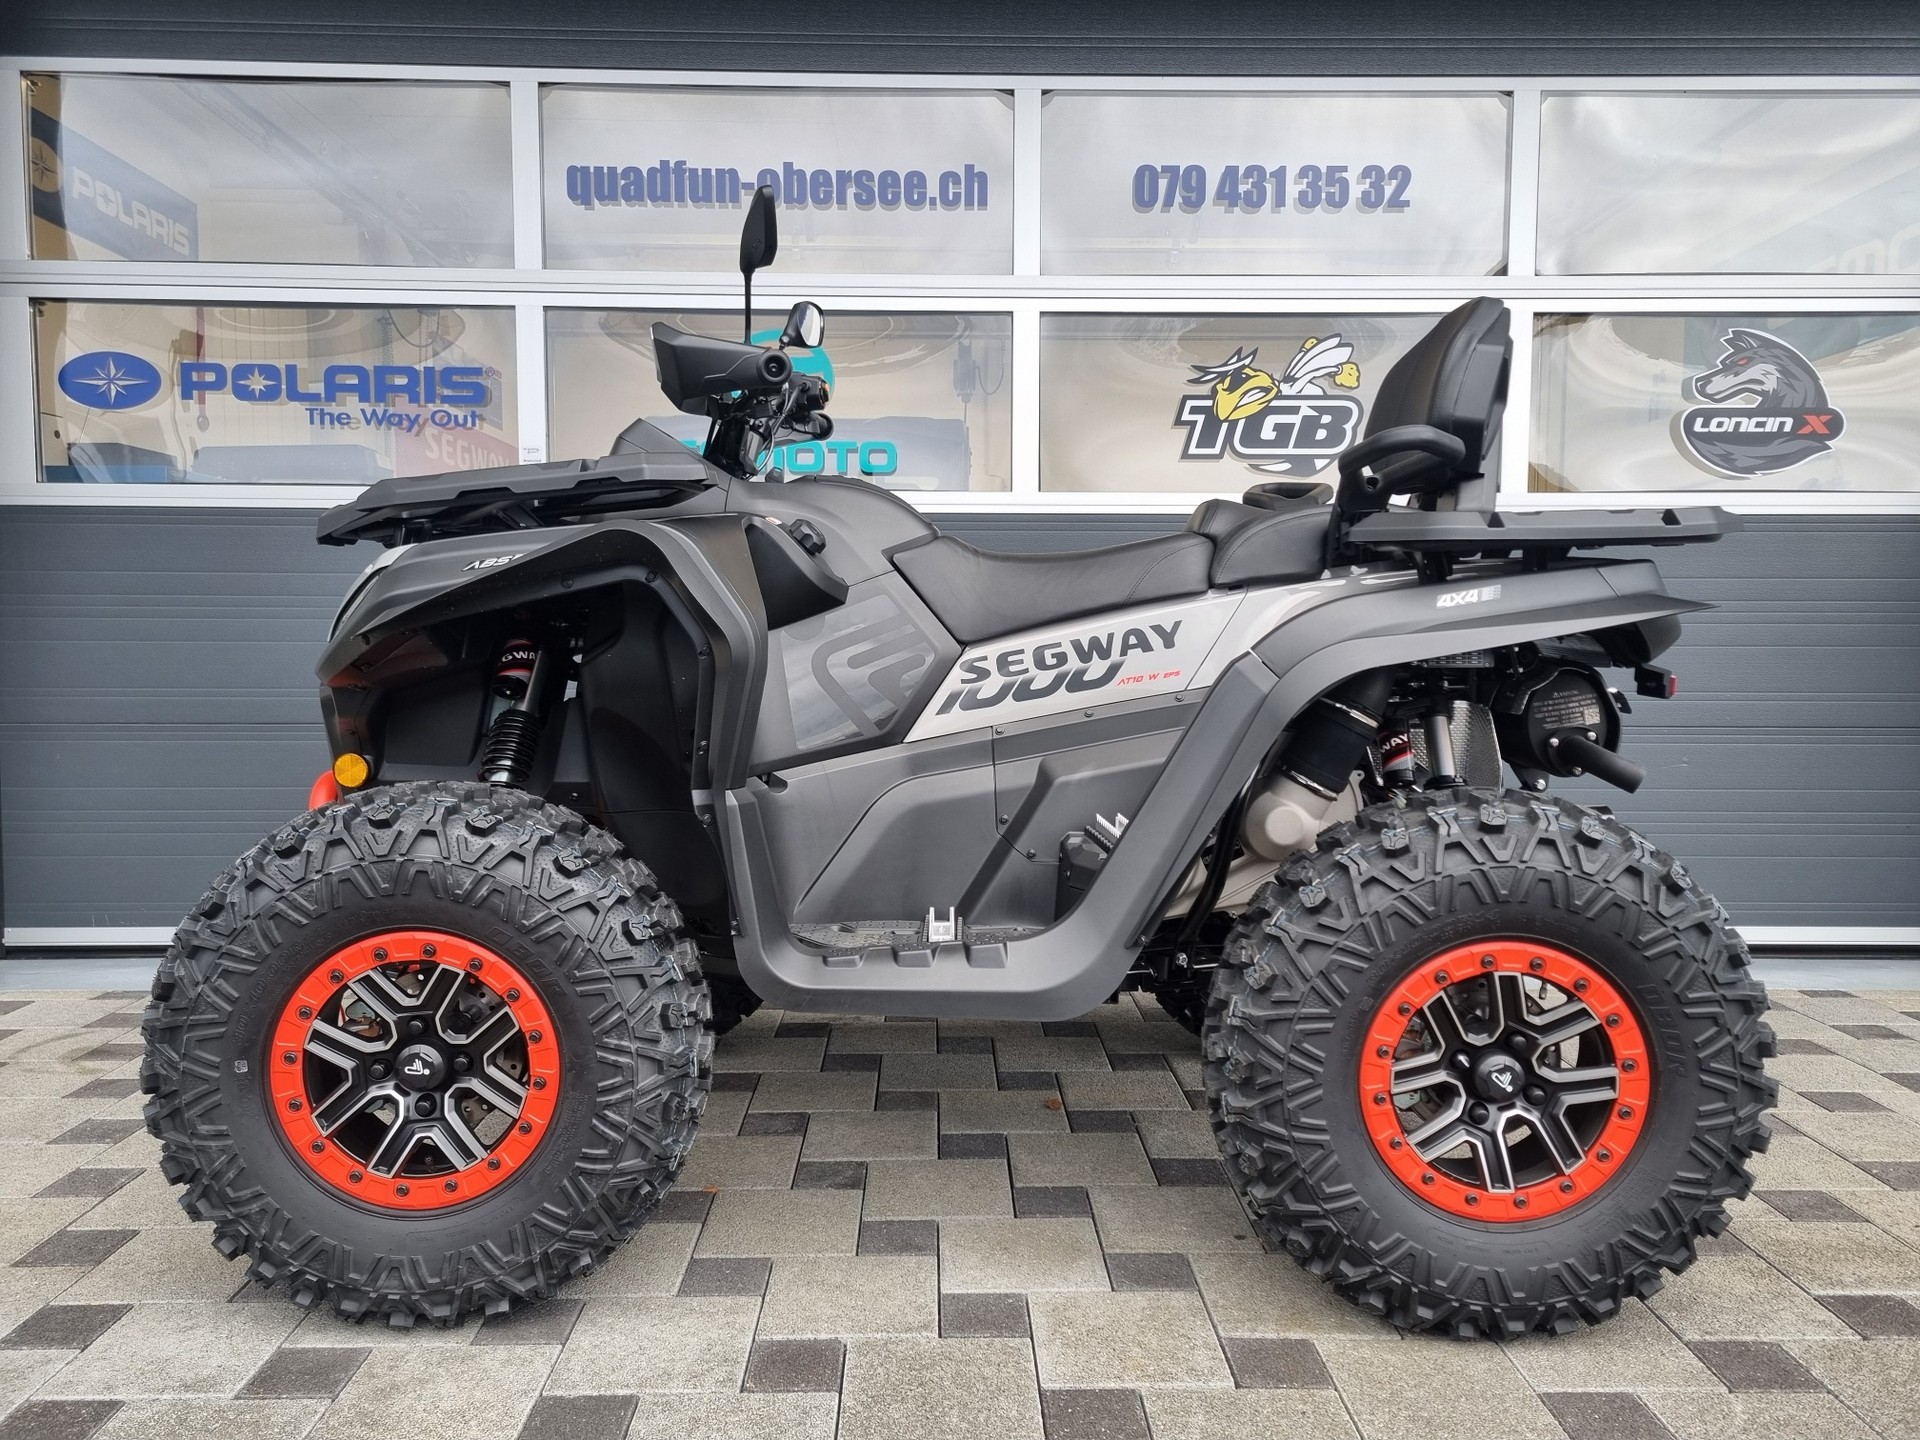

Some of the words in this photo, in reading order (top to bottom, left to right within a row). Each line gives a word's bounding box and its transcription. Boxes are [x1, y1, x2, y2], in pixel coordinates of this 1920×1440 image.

[566, 160, 988, 209] quadfun-obersee.ch
[1134, 164, 1207, 211] 079
[1214, 164, 1288, 211] 431
[1296, 164, 1350, 211] 35
[1359, 164, 1412, 211] 32
[72, 166, 190, 256] POLARIS
[180, 362, 486, 404] POLARIS
[305, 407, 351, 428] The
[360, 407, 421, 433] Way
[430, 409, 481, 429] Out
[1182, 398, 1360, 456] TGB
[1693, 416, 1794, 433] LONCIN
[1796, 414, 1833, 434] X
[1436, 589, 1479, 607] 4X4
[960, 620, 1183, 685] SEGWAY
[1117, 675, 1144, 686] AT10
[1148, 673, 1160, 681] W
[1163, 670, 1181, 679] EPS
